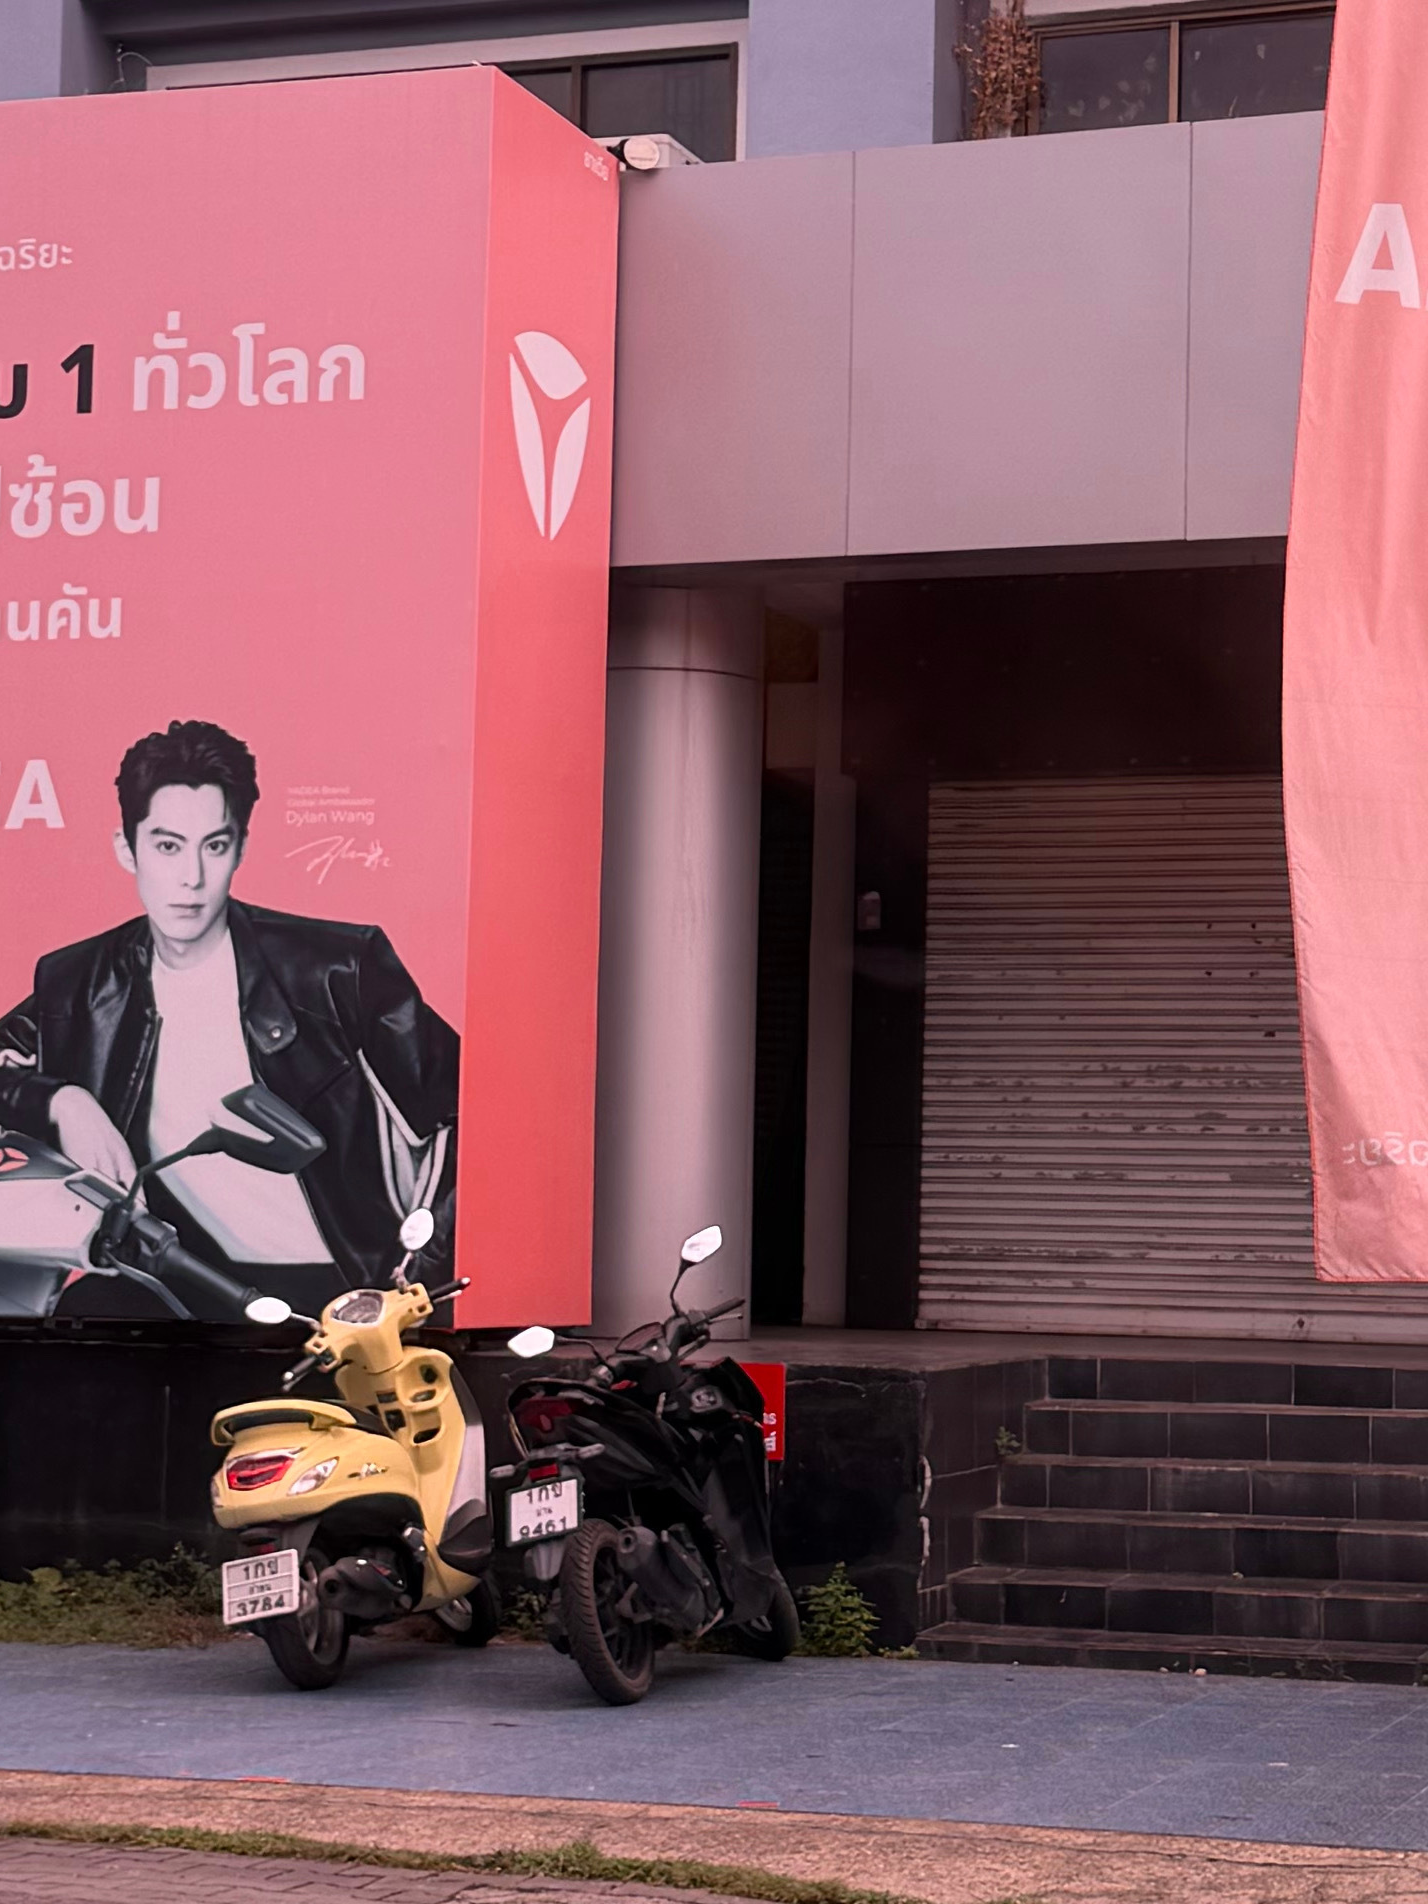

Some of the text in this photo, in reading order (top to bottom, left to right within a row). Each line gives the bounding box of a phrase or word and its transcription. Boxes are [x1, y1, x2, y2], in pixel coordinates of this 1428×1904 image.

[61, 344, 95, 415] 1
[133, 311, 366, 412] ทั่วโลก
[286, 810, 375, 828] Dylan Wang
[236, 1594, 285, 1617] 3784
